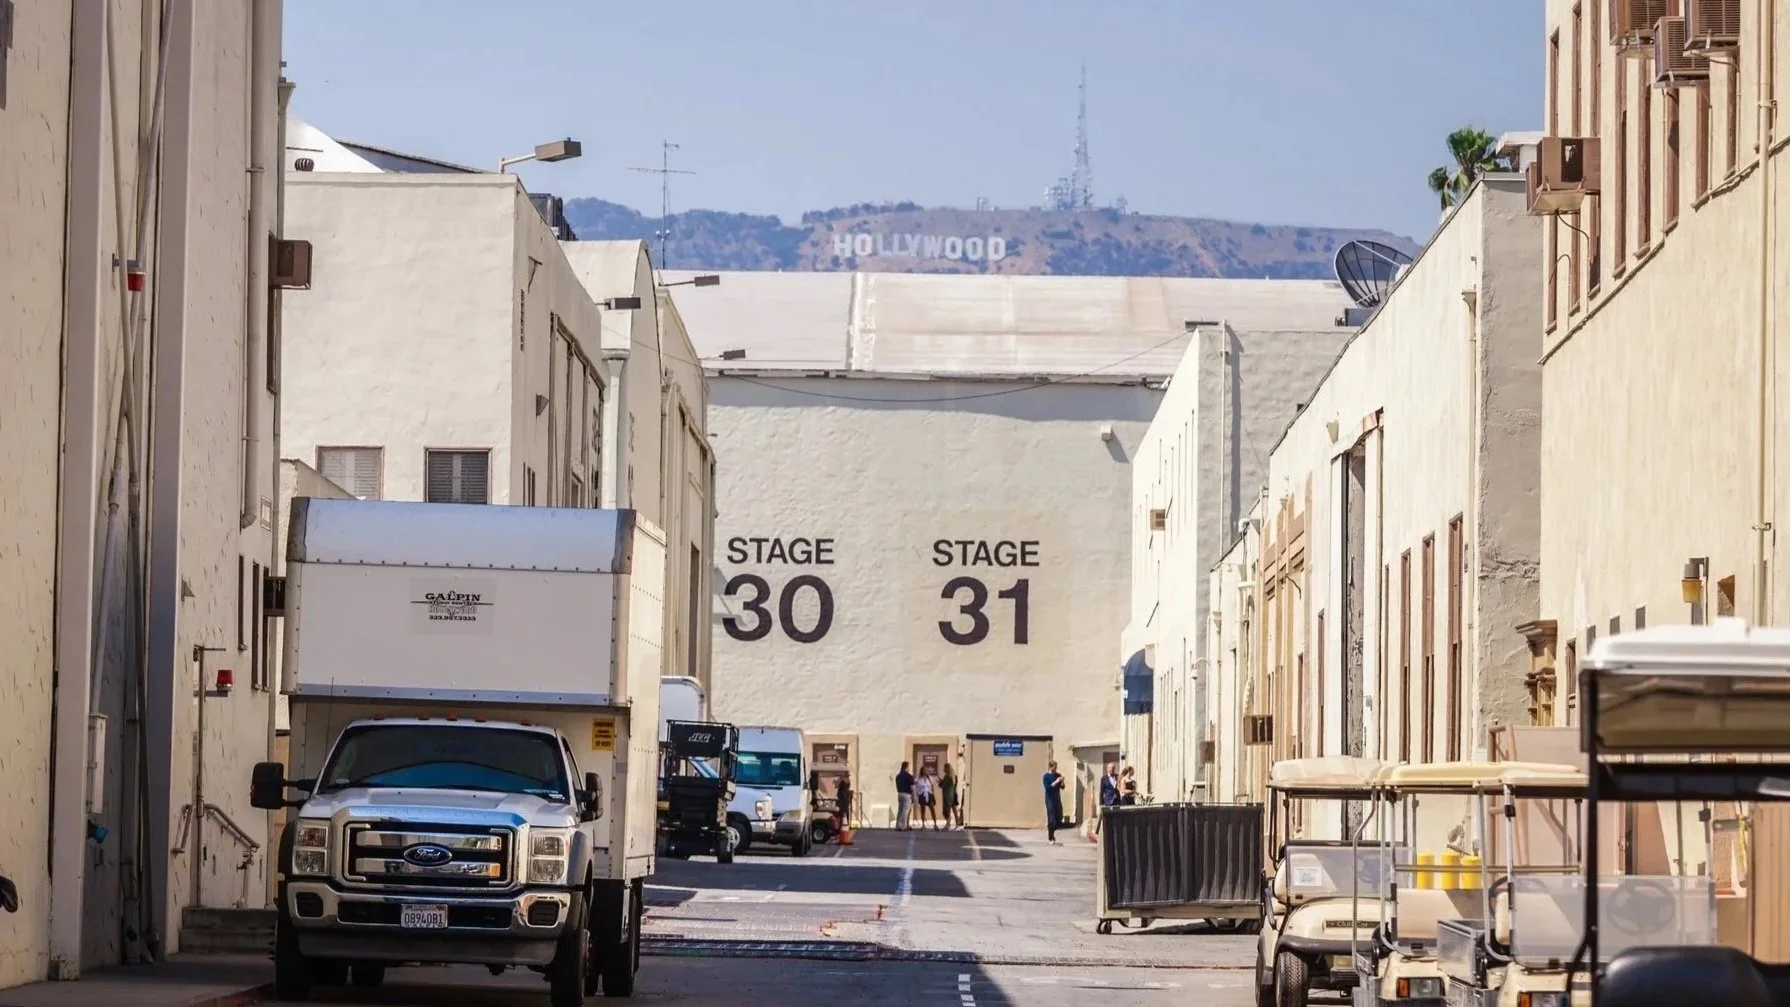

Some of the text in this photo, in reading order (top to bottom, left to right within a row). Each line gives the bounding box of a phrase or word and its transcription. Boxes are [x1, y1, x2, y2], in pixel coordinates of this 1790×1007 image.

[834, 233, 1006, 261] HOLLYWOOD
[727, 537, 834, 565] STAGE
[933, 540, 1040, 567] STAGE
[425, 592, 481, 602] GALPIN
[722, 573, 834, 643] 30
[938, 576, 1029, 645] 31
[415, 848, 441, 860] Ford
